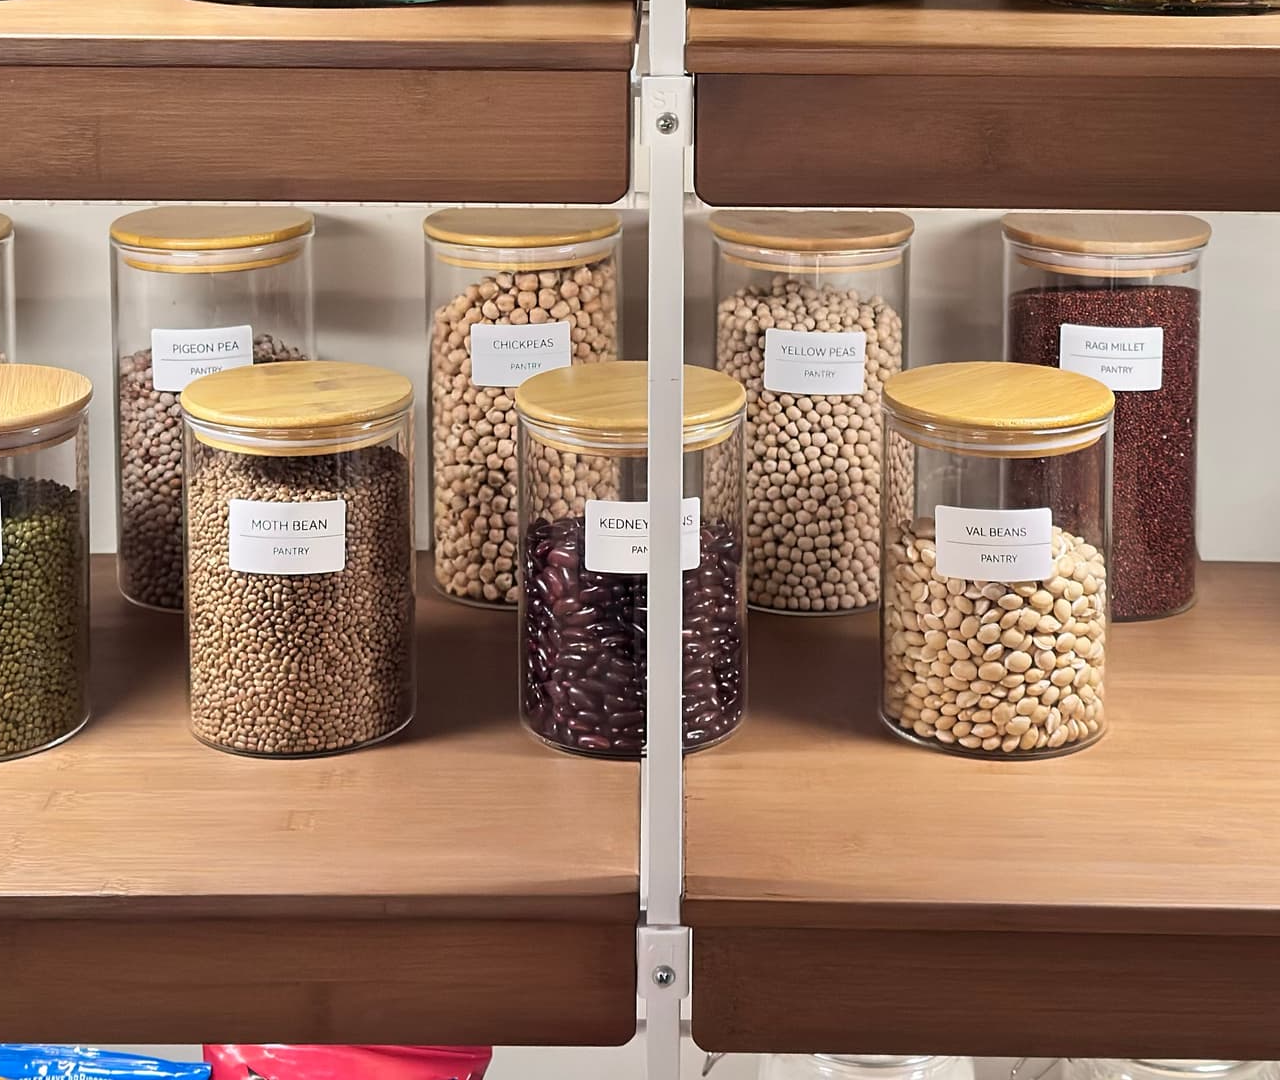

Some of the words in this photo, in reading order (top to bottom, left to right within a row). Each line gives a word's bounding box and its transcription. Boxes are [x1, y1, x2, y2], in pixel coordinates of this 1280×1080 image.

[172, 343, 214, 354] PIGEON
[217, 341, 240, 352] PEA
[493, 338, 554, 350] CHICKPEAS
[1084, 341, 1111, 352] RAGI
[1112, 340, 1145, 352] MILLET
[780, 344, 827, 357] YELLOW
[828, 346, 857, 358] PEAS
[510, 363, 542, 371] PANTRY
[1100, 365, 1133, 374] PANTRY
[803, 370, 836, 379] PANTRY
[251, 518, 290, 532] MOTH
[292, 518, 329, 531] BEAN
[599, 518, 648, 530] KEDNEY
[965, 526, 987, 538] VAL
[989, 526, 1028, 538] BEANS
[272, 546, 311, 556] PANTRY
[980, 554, 1019, 565] PANTRY
